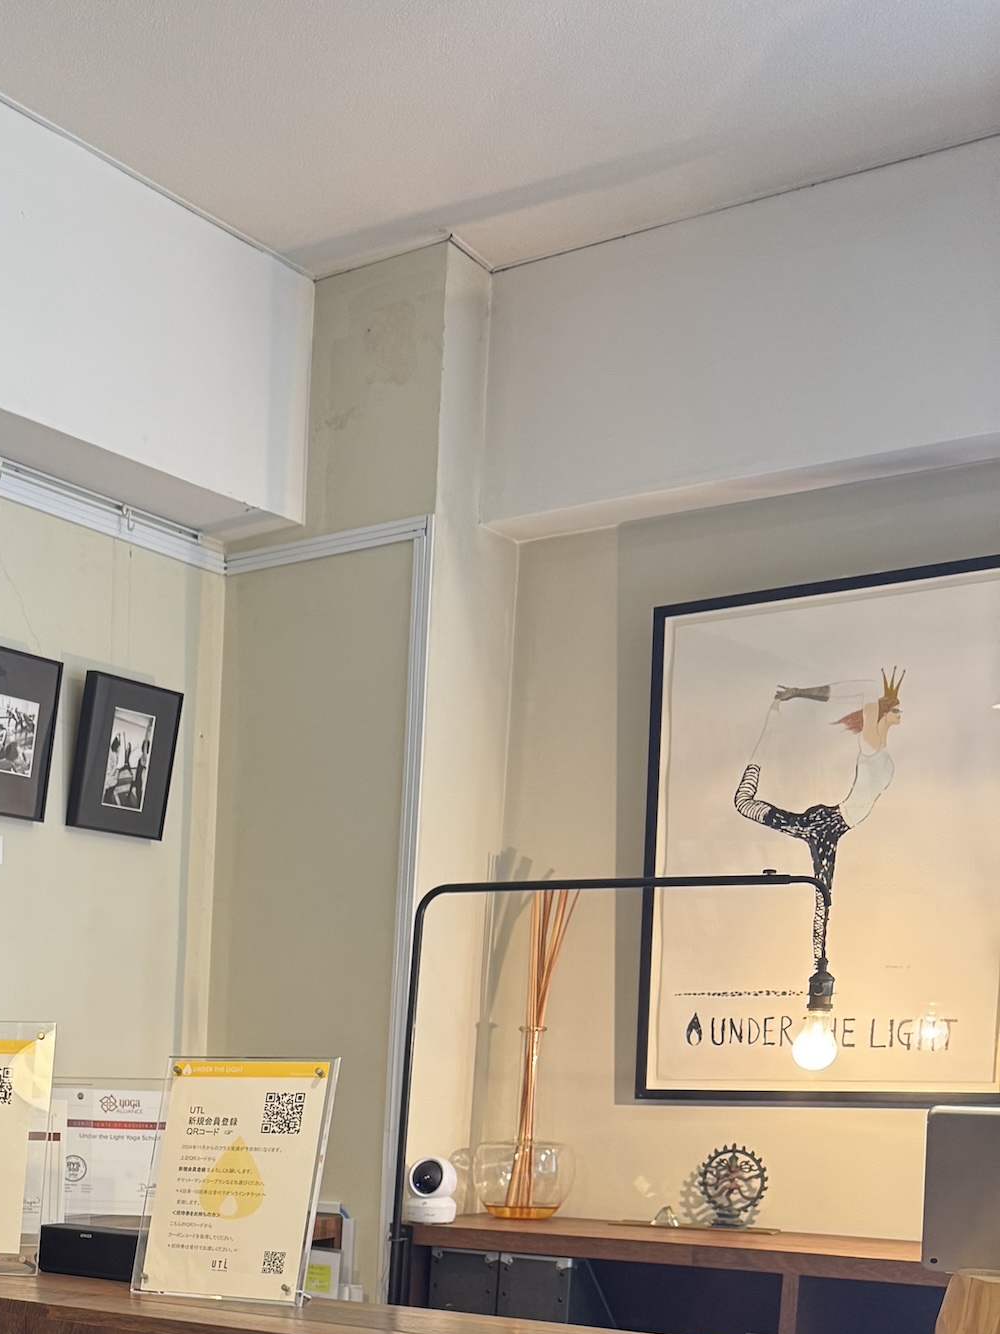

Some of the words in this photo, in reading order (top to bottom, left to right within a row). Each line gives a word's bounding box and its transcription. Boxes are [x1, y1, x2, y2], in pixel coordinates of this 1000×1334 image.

[709, 1015, 793, 1047] UNDER
[869, 1017, 958, 1052] LIGHT
[119, 1099, 140, 1108] yoga
[190, 1106, 205, 1114] UTL
[188, 1117, 238, 1126] 新規会員登録
[186, 1127, 219, 1136] QRコード
[211, 1258, 228, 1269] UTL
